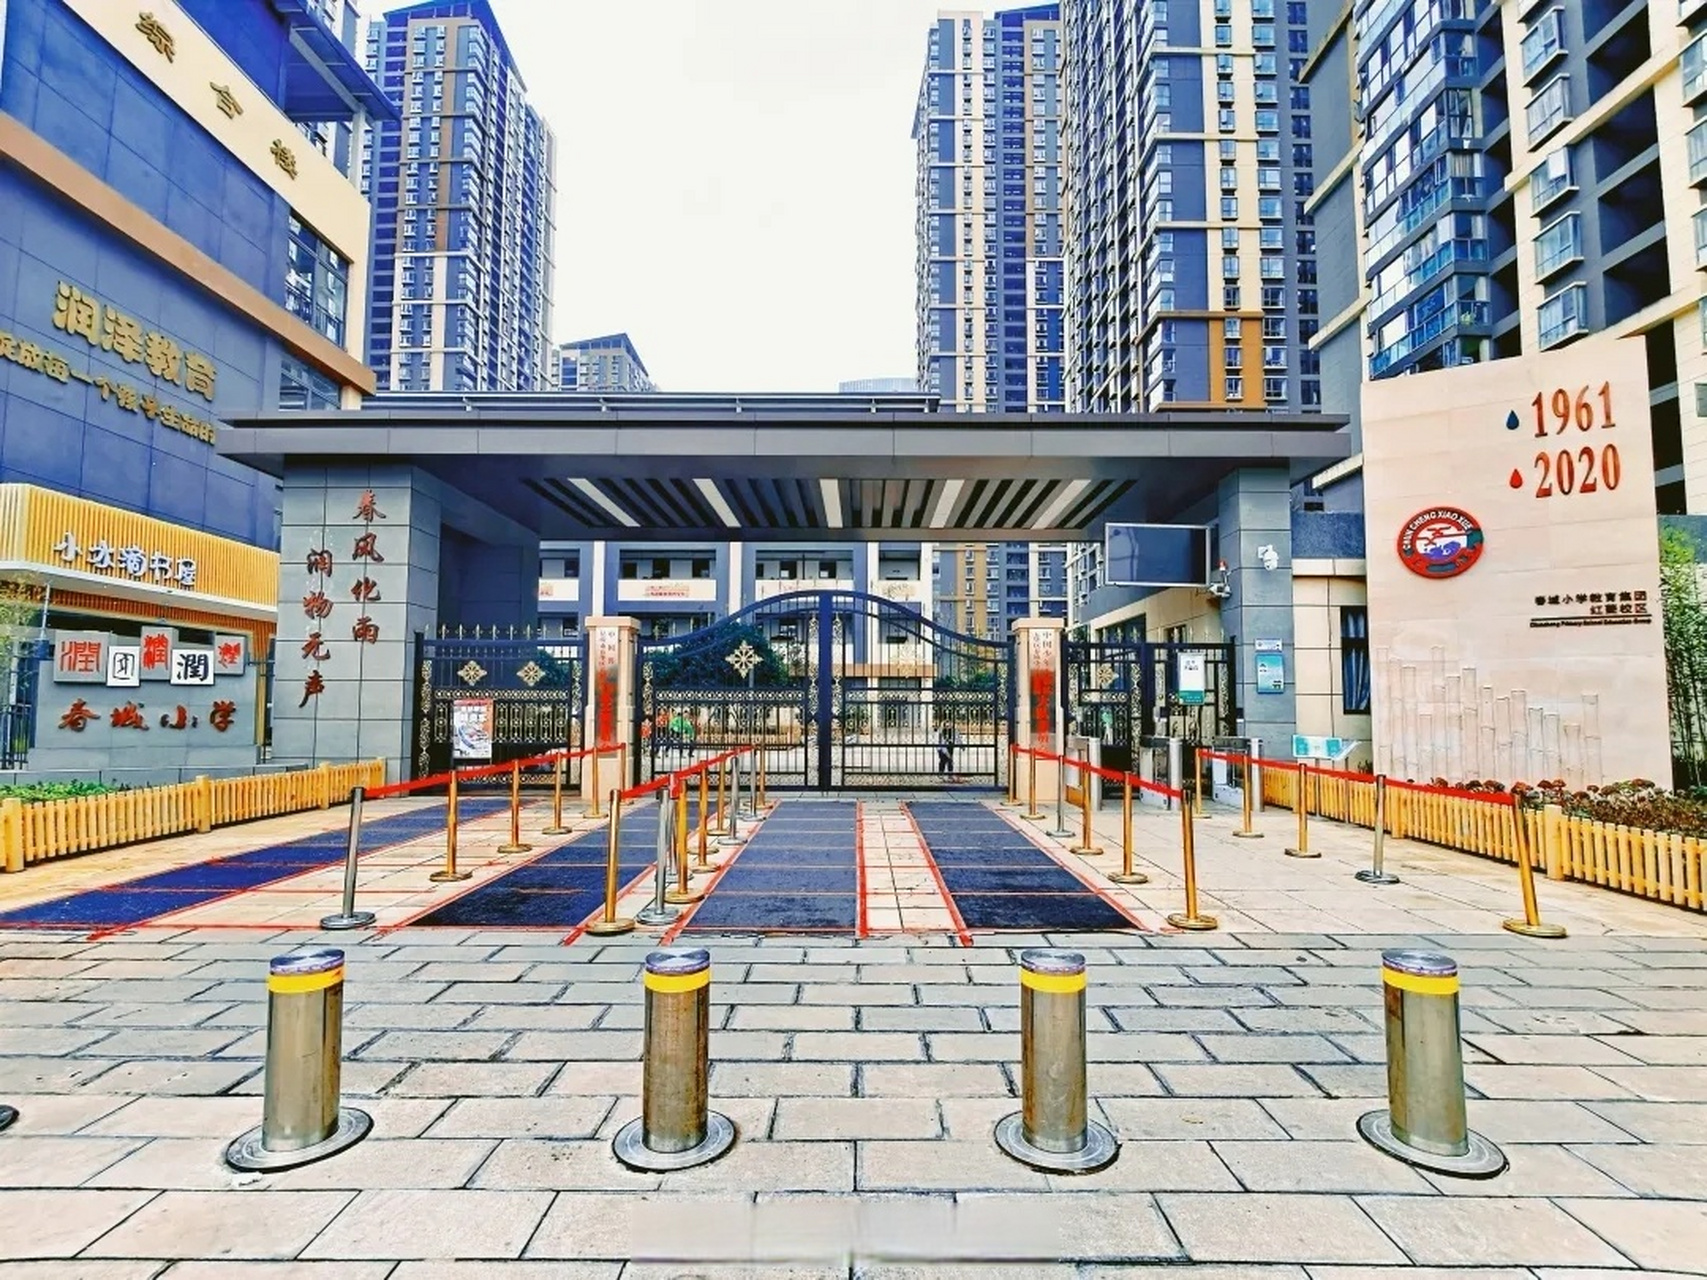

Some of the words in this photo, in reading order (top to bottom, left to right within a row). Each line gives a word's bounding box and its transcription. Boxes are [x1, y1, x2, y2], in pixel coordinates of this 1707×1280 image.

[52, 281, 217, 402] 润泽教育
[1531, 381, 1616, 438] 1961
[1534, 443, 1621, 498] 2020
[1438, 510, 1458, 520] XIAO
[53, 530, 197, 586] 小水滴书屋
[352, 489, 387, 645] 春风化雨
[1535, 591, 1647, 606] 春城小学教育集团
[58, 699, 237, 732] 春城小学
